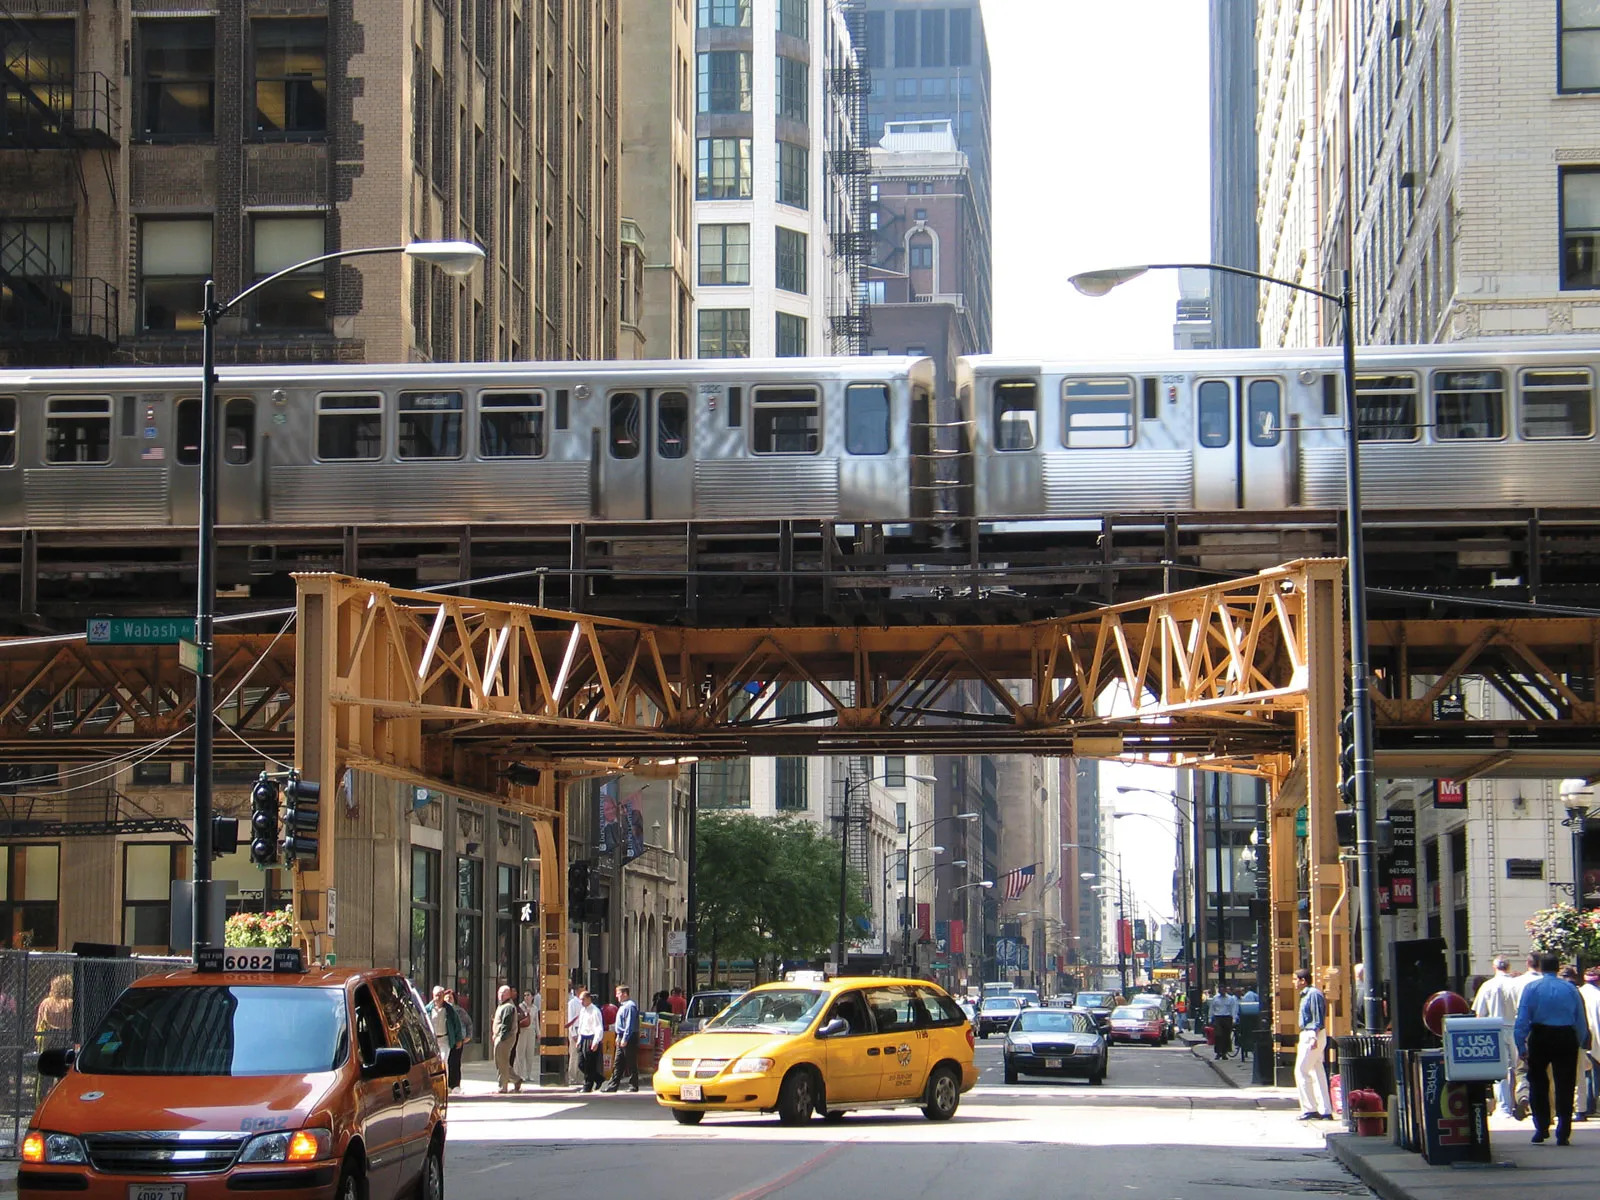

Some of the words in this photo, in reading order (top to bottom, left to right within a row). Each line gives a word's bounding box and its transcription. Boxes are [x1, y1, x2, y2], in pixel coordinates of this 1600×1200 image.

[114, 625, 120, 633] S
[123, 622, 177, 637] Wabash
[1394, 884, 1412, 897] MR
[225, 955, 273, 970] 6082
[1468, 1035, 1494, 1046] USA
[1455, 1046, 1496, 1058] TODAY
[240, 1116, 289, 1132] 6082
